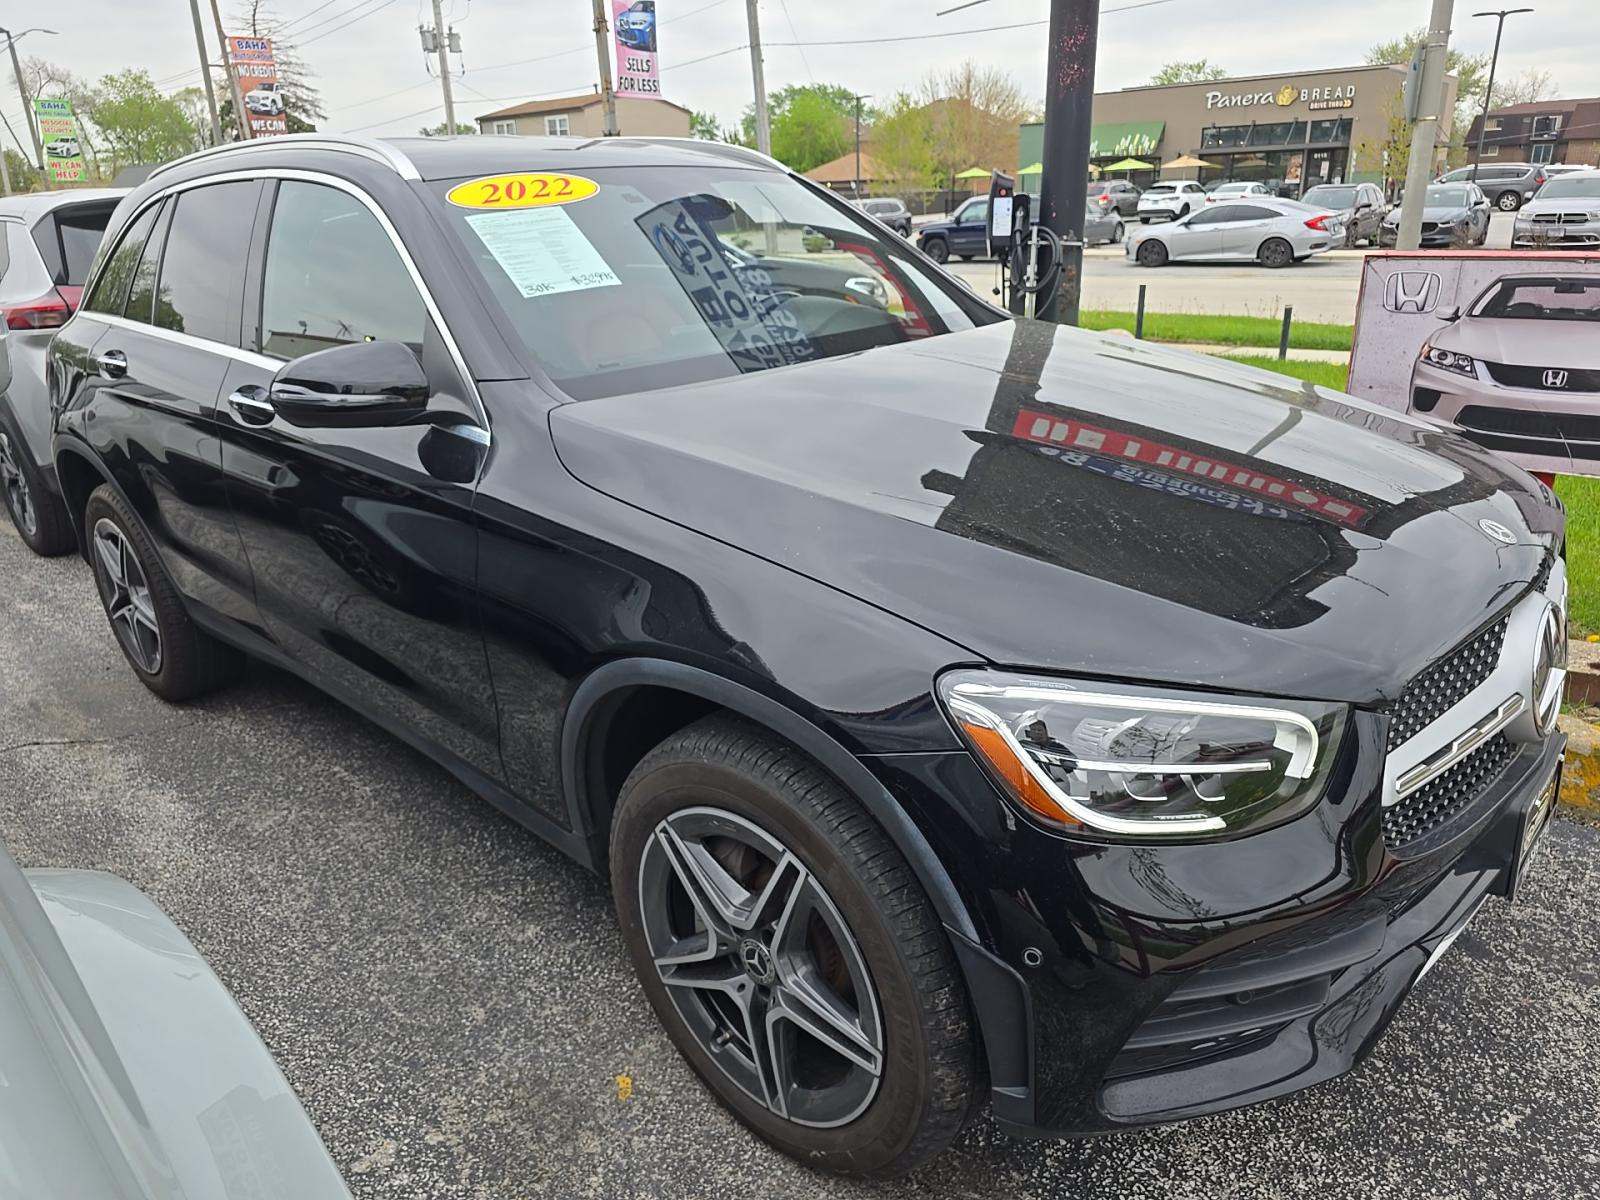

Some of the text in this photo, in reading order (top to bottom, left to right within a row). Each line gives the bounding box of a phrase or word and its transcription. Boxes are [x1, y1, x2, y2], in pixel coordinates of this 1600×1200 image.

[237, 40, 268, 51] BAHA
[238, 64, 275, 78] NO CREDIT
[626, 58, 651, 73] SELLS
[619, 76, 636, 92] FOR
[1205, 85, 1356, 110] Panera BREAD
[1310, 101, 1327, 110] DRIVE
[251, 119, 286, 131] WE CAN
[51, 161, 82, 169] WE CAN
[56, 171, 79, 180] HELP
[480, 177, 574, 206] 2022
